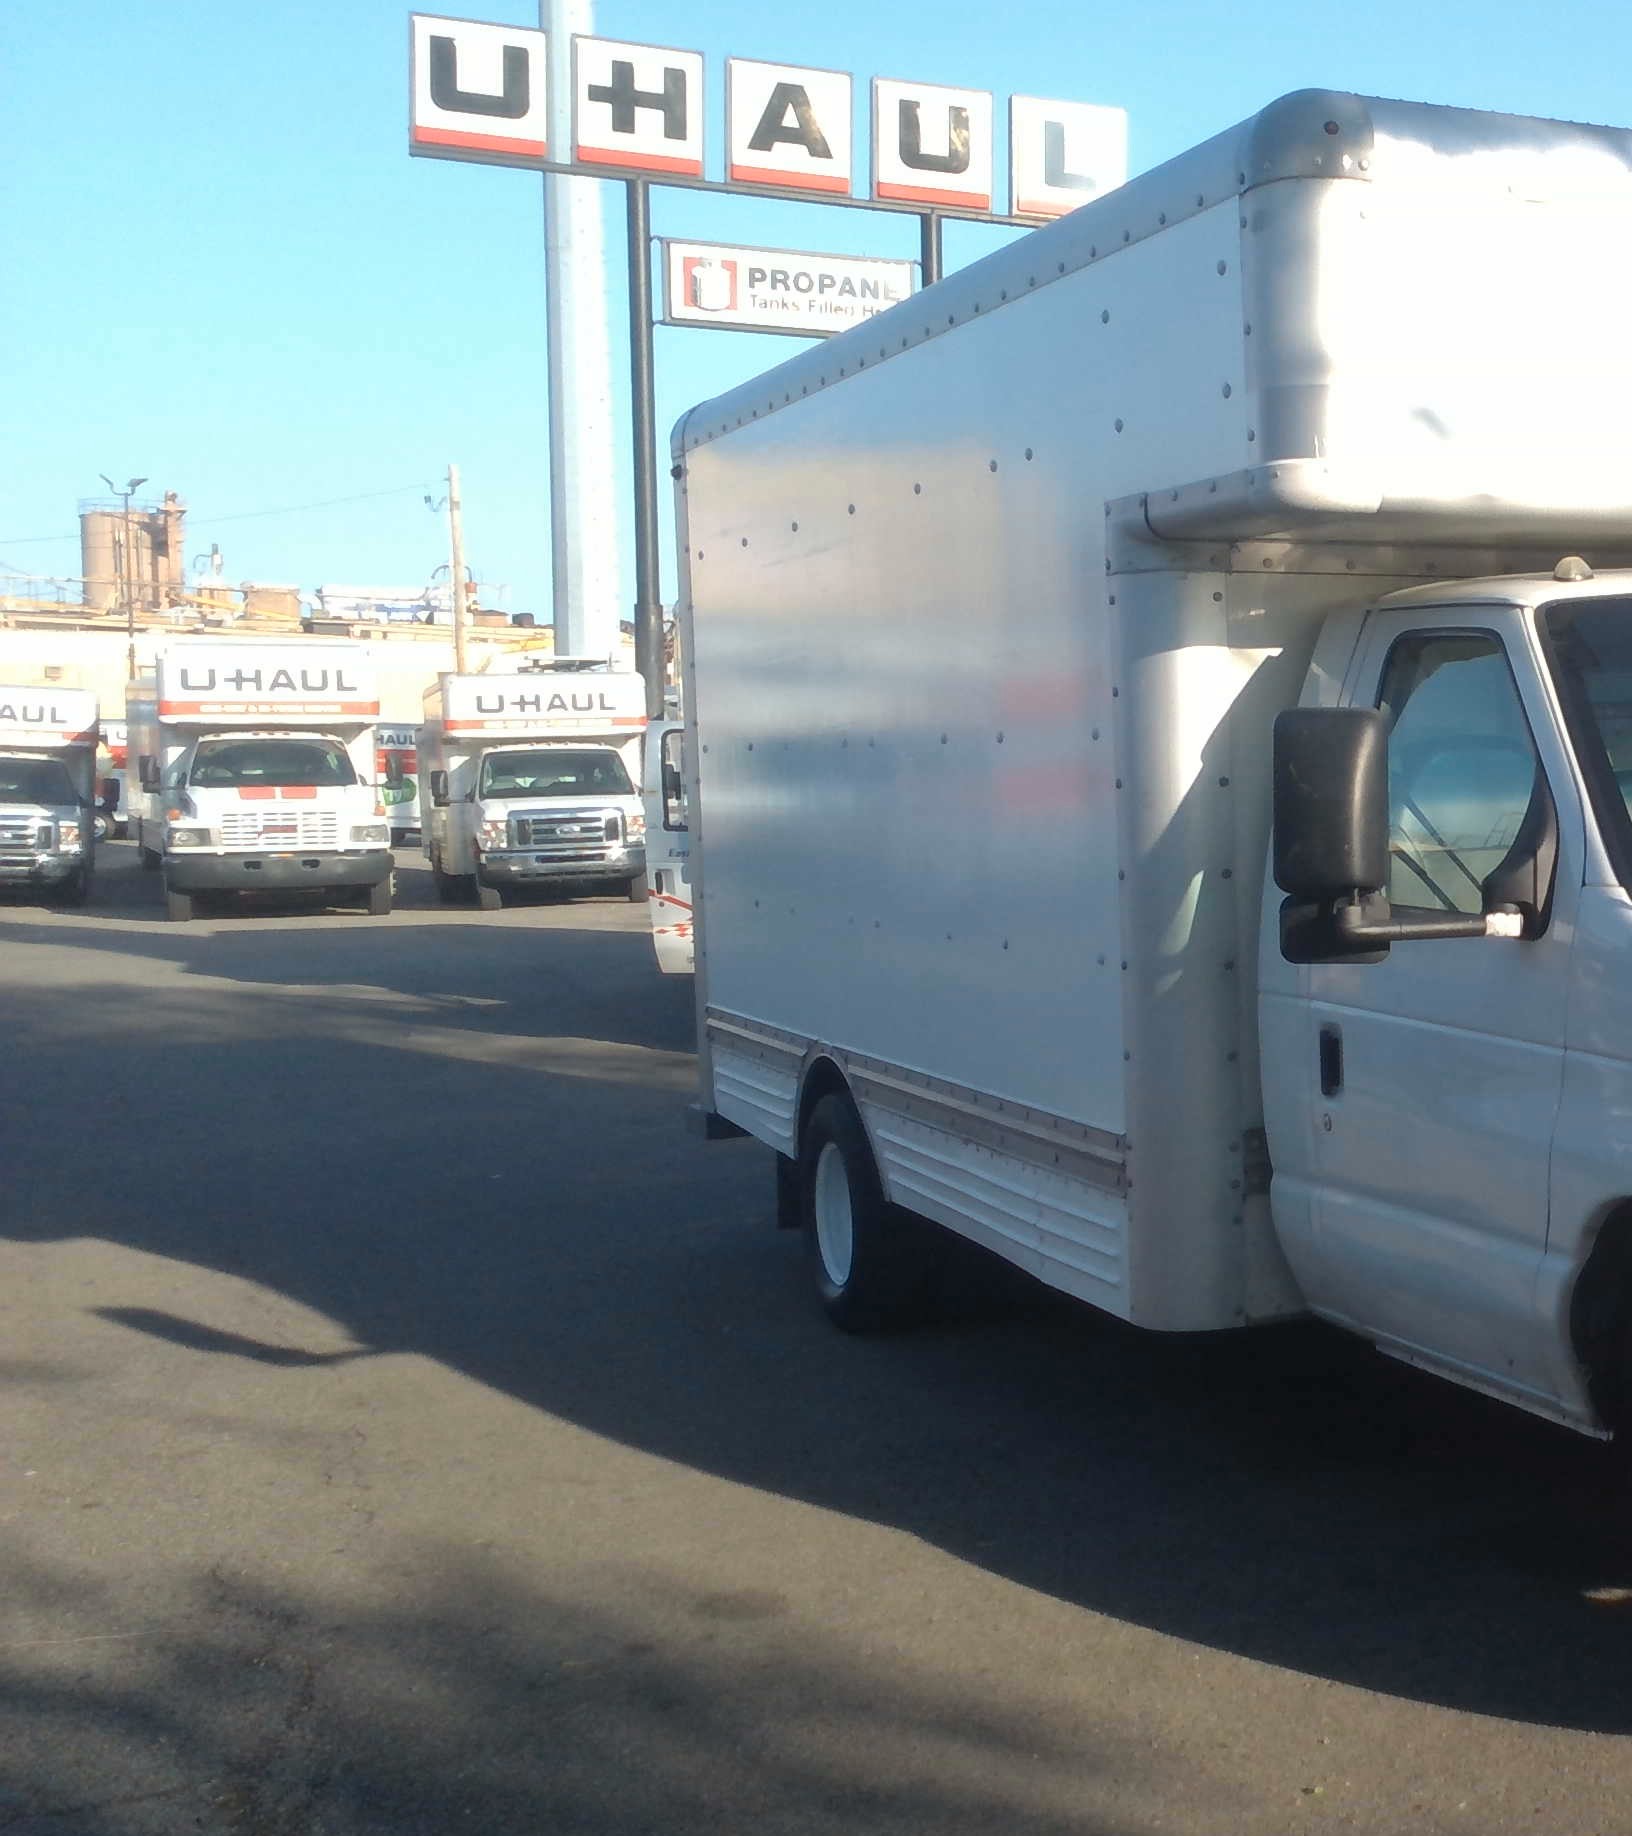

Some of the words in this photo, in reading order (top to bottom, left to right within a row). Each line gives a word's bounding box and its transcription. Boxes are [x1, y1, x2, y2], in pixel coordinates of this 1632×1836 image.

[748, 267, 900, 302] PROPANE
[750, 294, 801, 312] Tanks
[180, 668, 358, 692] U-HAUL
[475, 692, 617, 714] U-HAUL
